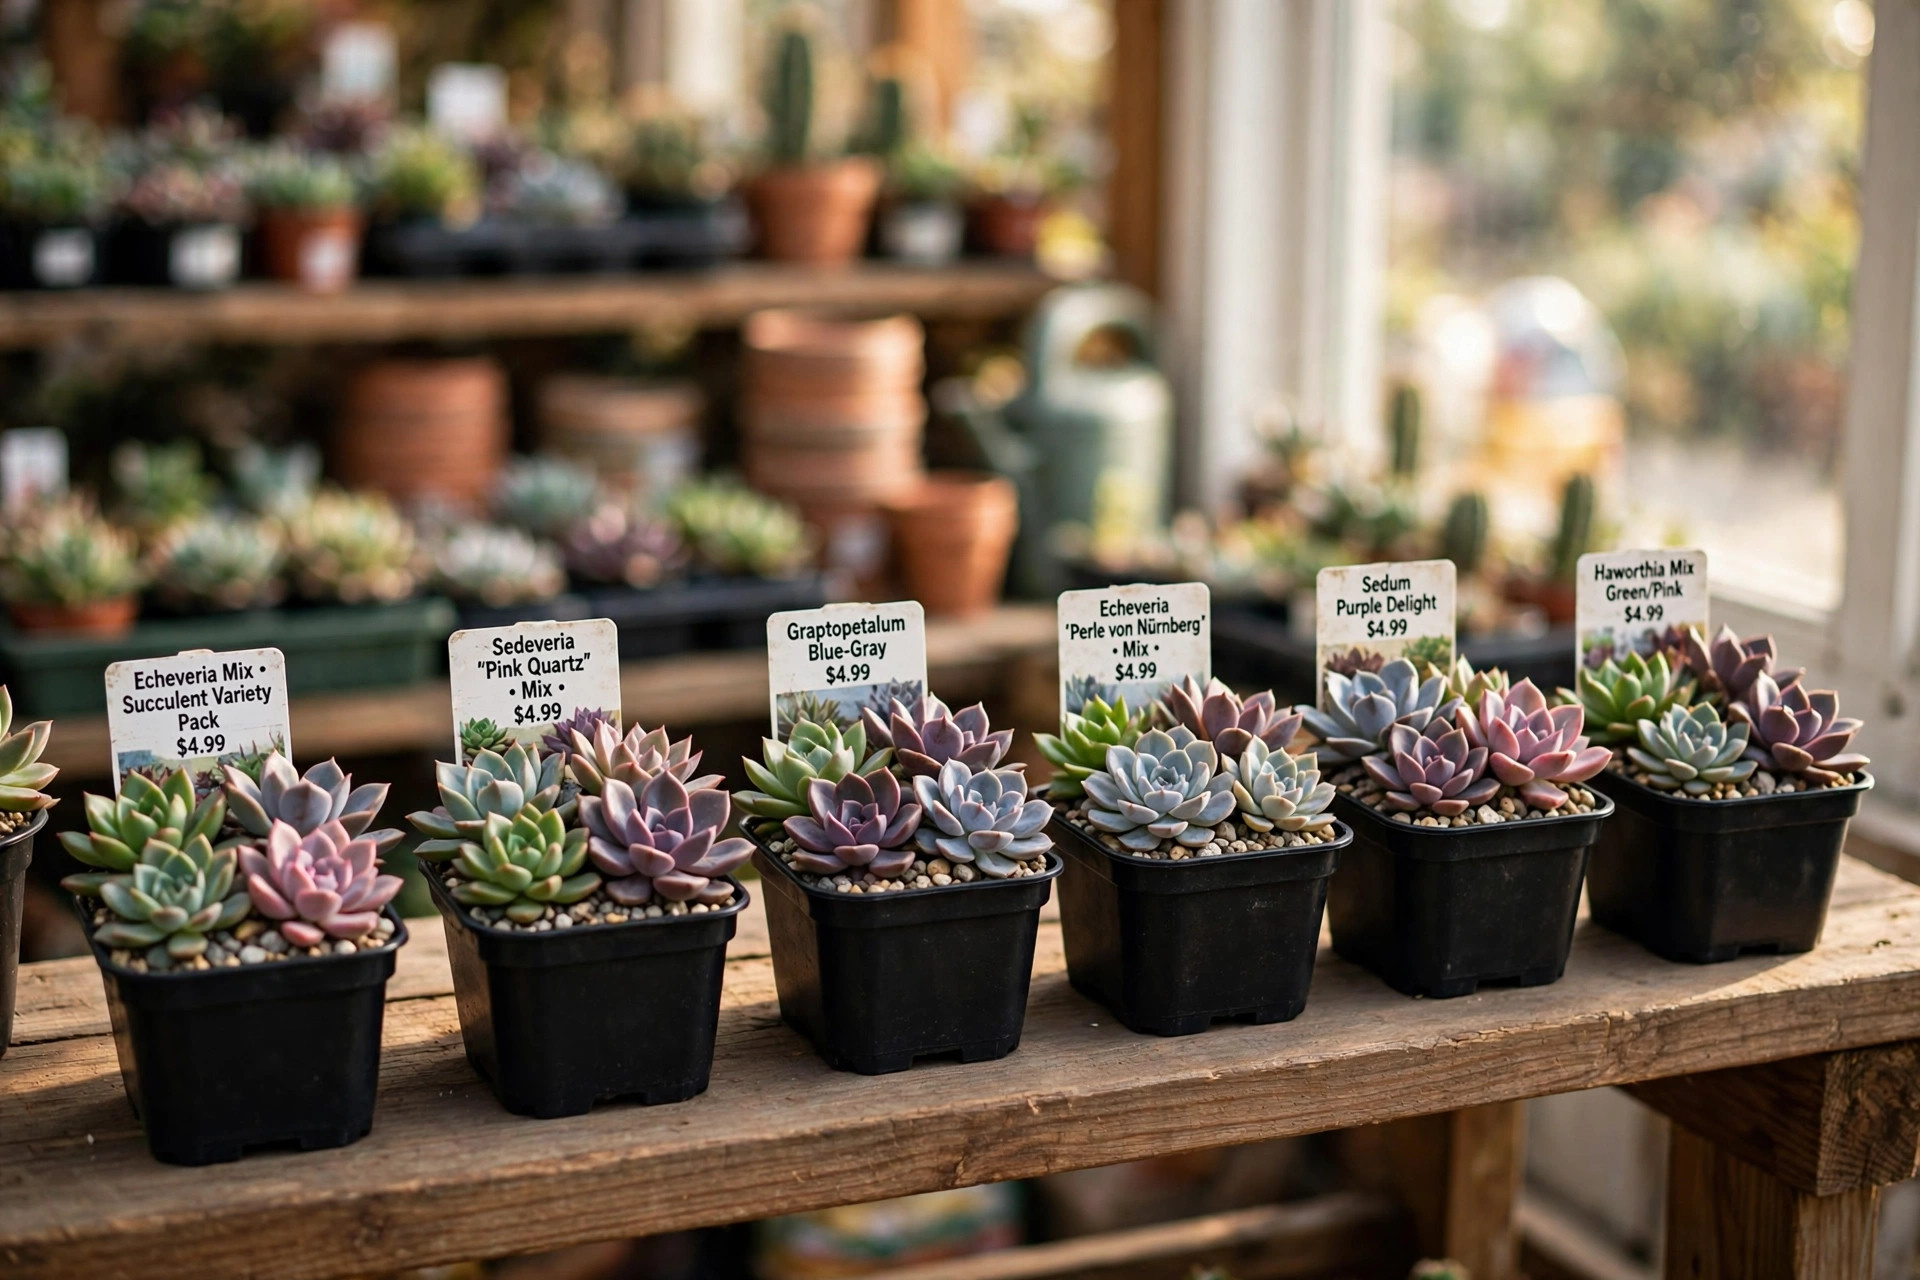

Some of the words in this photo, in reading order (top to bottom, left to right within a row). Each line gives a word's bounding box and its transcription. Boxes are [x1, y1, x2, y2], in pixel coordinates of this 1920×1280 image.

[1595, 561, 1665, 580] Haworthia
[1670, 560, 1694, 576] Mix
[1362, 574, 1410, 593] Sedum
[1606, 580, 1683, 601] Green/Pink
[1100, 597, 1169, 617] Echeveria
[1337, 597, 1382, 618] Purple
[1387, 594, 1437, 615] Delight
[1625, 605, 1663, 623] $4.99
[787, 615, 905, 642] Graptopetalum
[1109, 624, 1132, 637] von
[1367, 619, 1407, 638] $4.99
[493, 633, 575, 656] Sedeveria
[809, 640, 887, 661] Blue-Gray
[1123, 641, 1149, 657] Mix
[134, 666, 217, 690] Echeveria
[222, 662, 254, 682] Mix
[826, 664, 870, 685] $4.99
[1115, 662, 1157, 681] $4.99
[123, 690, 208, 714] Succulent
[212, 685, 272, 705] Variety
[522, 680, 553, 699] Mix
[178, 711, 220, 731] Pack
[514, 703, 562, 725] $4.99
[177, 734, 225, 758] $4.99
